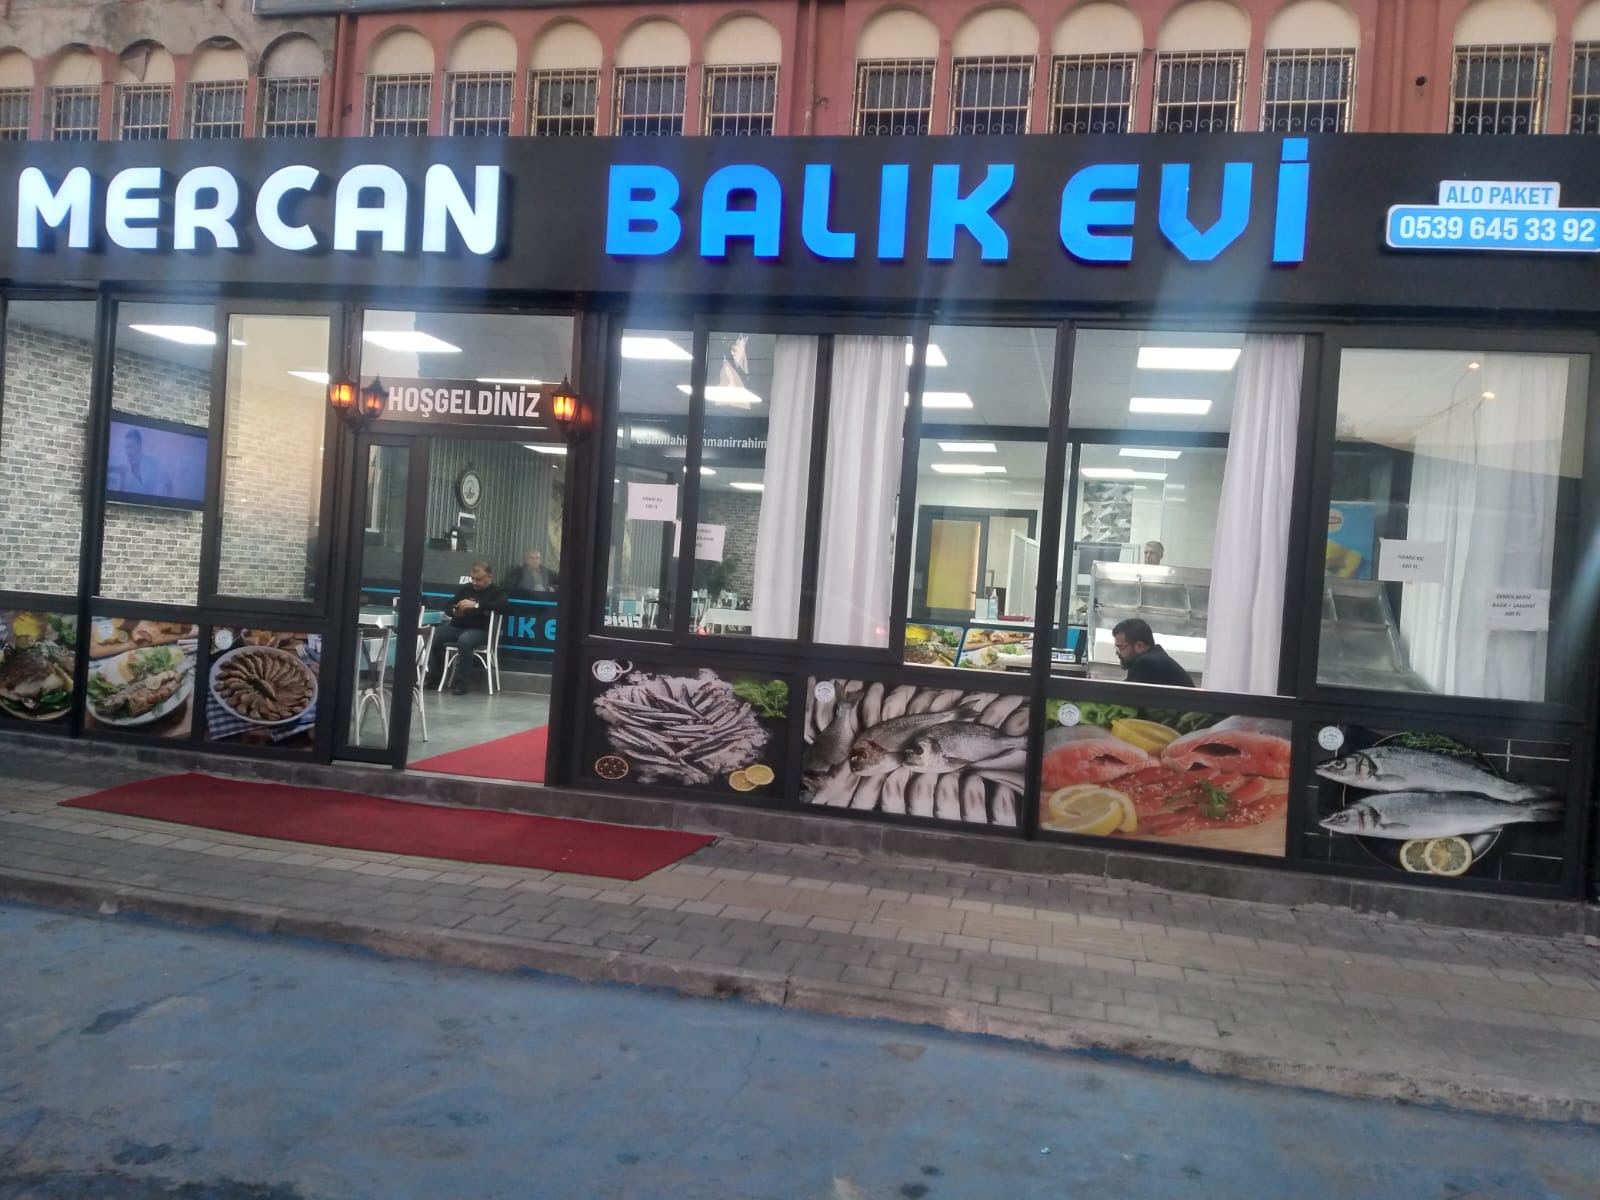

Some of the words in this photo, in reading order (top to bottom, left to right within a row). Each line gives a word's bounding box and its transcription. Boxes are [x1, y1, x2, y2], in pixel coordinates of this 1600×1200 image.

[16, 163, 501, 255] MERCAN
[604, 163, 1015, 261] BALIK
[1058, 137, 1311, 262] EVİ
[1445, 186, 1484, 203] ALO
[1488, 187, 1554, 204] PAKET
[1399, 215, 1464, 239] 0539
[1469, 216, 1519, 240] 645
[1524, 217, 1556, 241] 33
[1562, 218, 1597, 242] 92
[388, 384, 541, 418] HOŞGELDİNİZ
